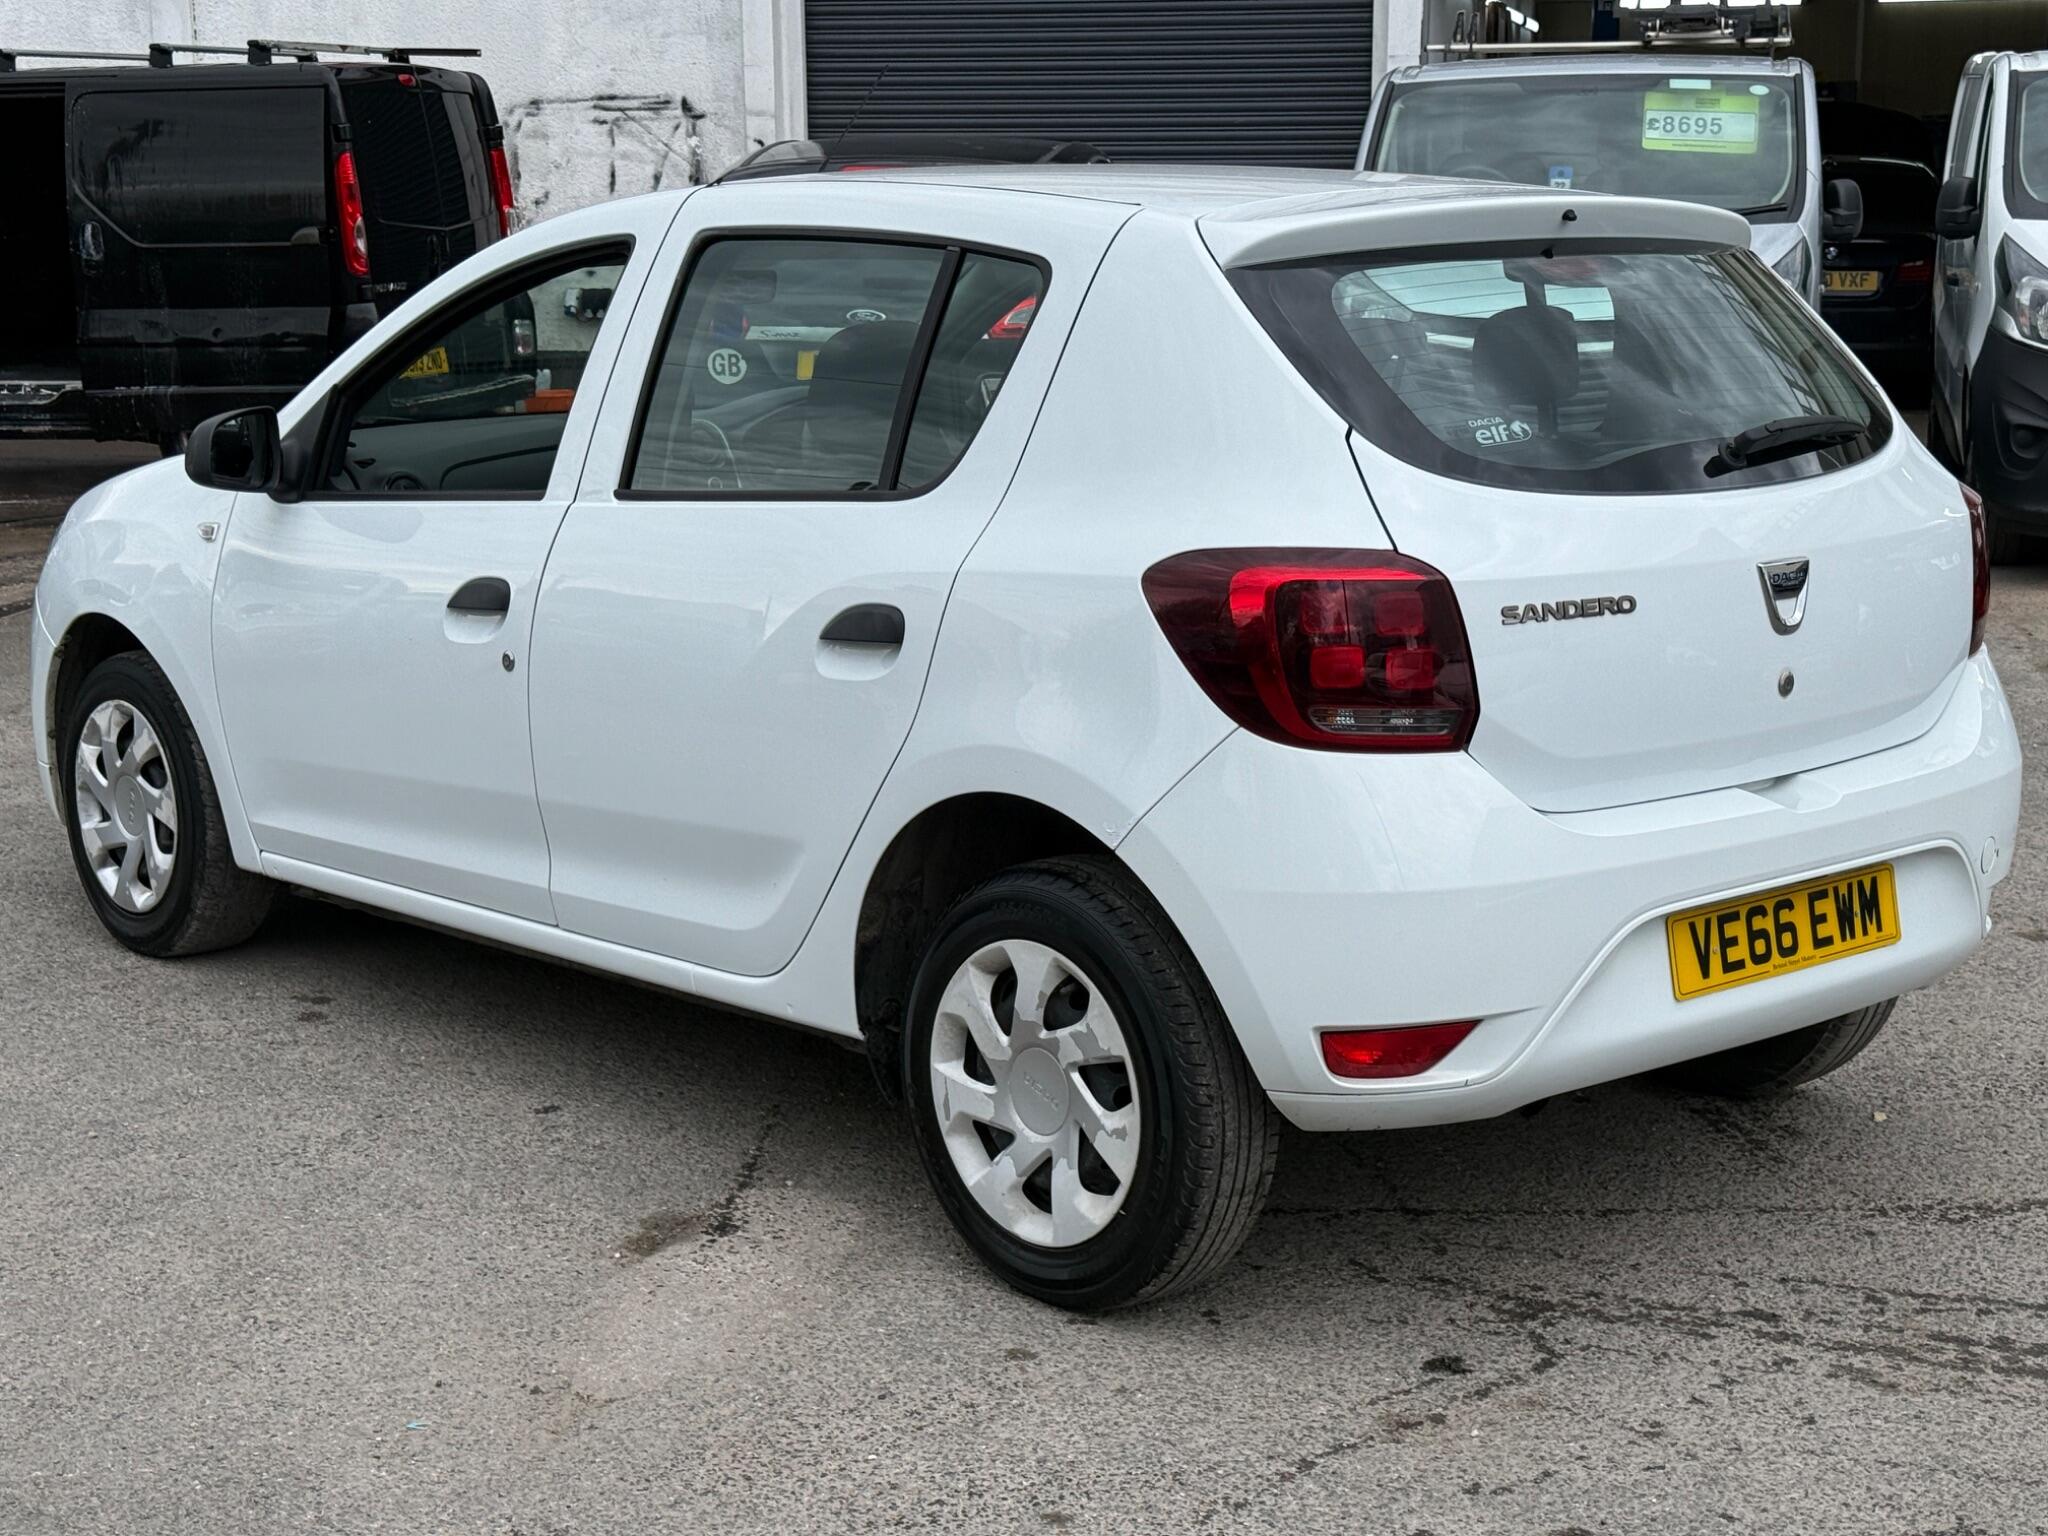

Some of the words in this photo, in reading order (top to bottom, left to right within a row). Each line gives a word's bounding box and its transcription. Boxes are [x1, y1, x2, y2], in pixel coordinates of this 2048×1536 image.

[1646, 115, 1722, 135] £8695
[1838, 272, 1870, 288] VXF
[712, 353, 742, 376] GB
[1468, 417, 1504, 428] DACIA
[1476, 424, 1509, 444] elf
[1501, 595, 1637, 625] SANDERO
[1688, 898, 1799, 980] VE66
[1808, 876, 1883, 950] EWM
